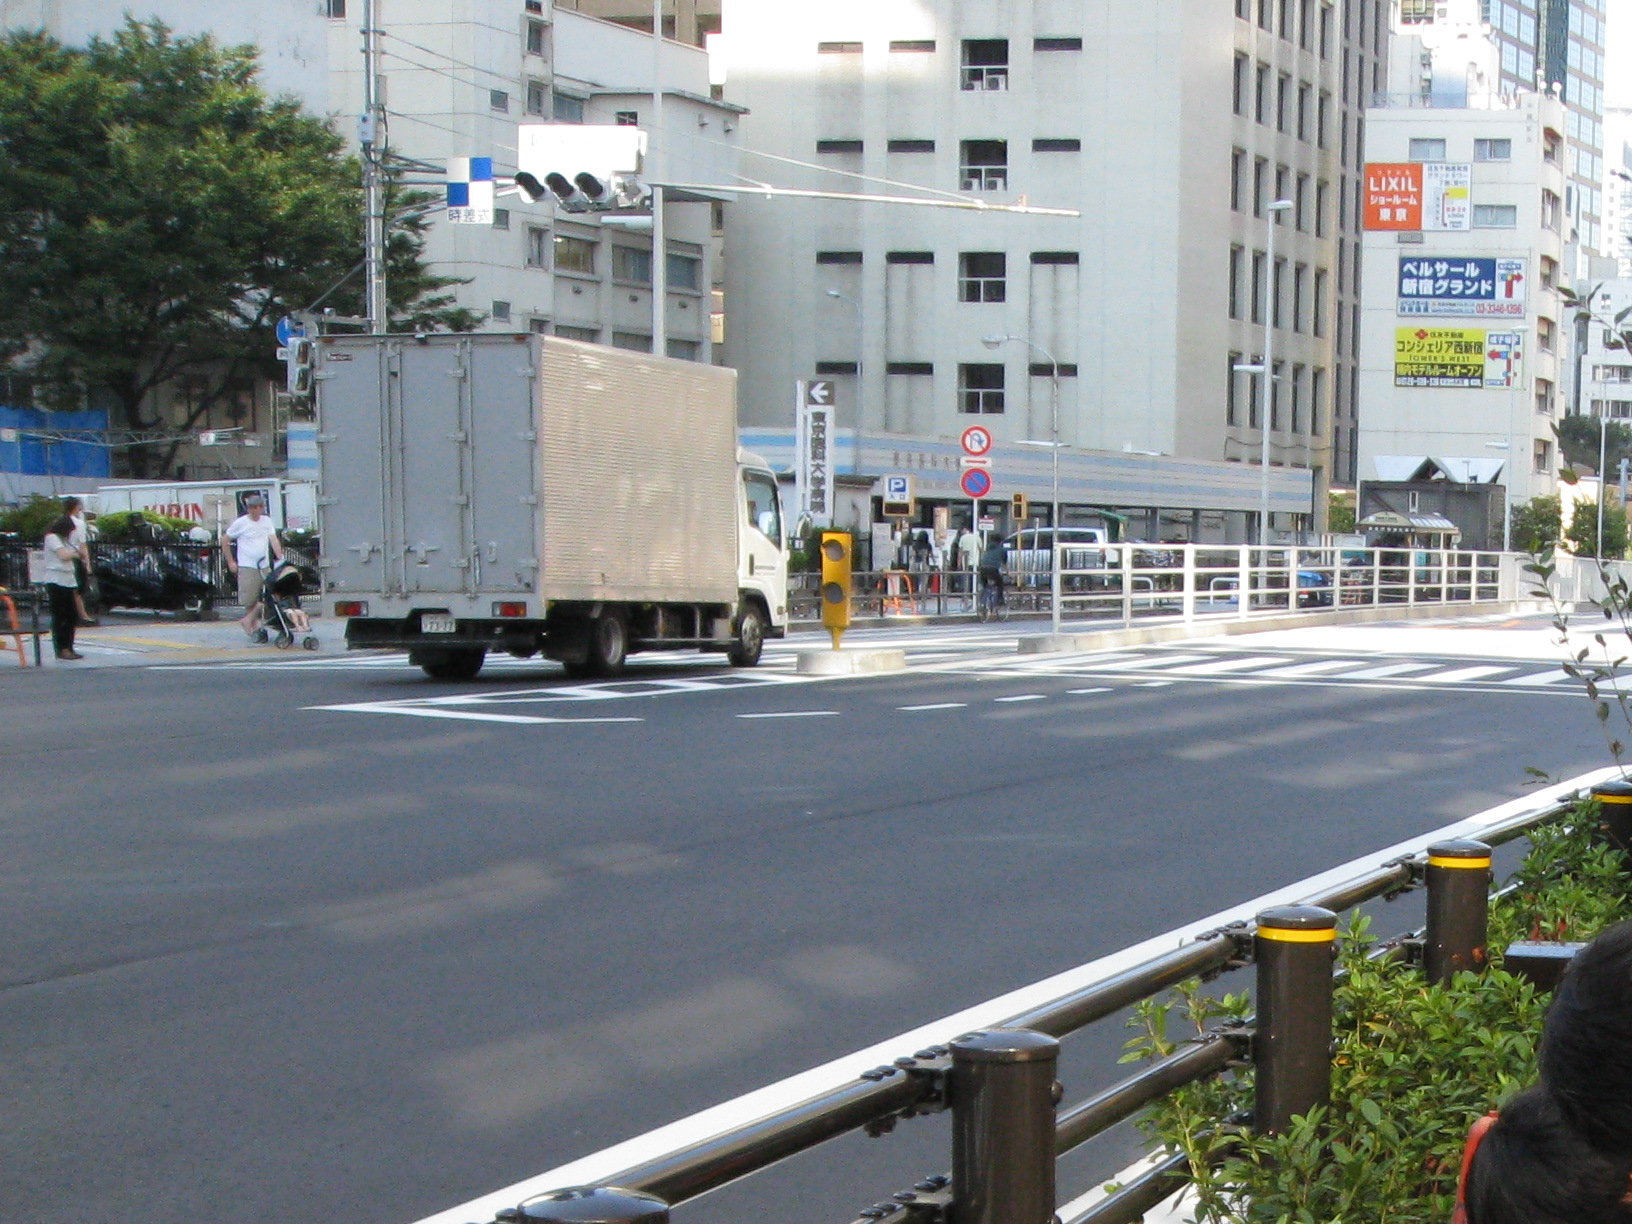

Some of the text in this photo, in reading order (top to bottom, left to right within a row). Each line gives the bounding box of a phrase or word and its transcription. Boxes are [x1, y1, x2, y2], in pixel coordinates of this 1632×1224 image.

[1369, 176, 1418, 192] LIXIL
[1370, 194, 1418, 205] ショールーム
[448, 207, 491, 223] 時差式
[1379, 208, 1407, 221] 東京
[1402, 261, 1480, 277] ベルサール
[1401, 278, 1493, 296] 新宿グランド
[1396, 341, 1483, 354] コンシェリア西新宿
[144, 503, 206, 524] KIRIN
